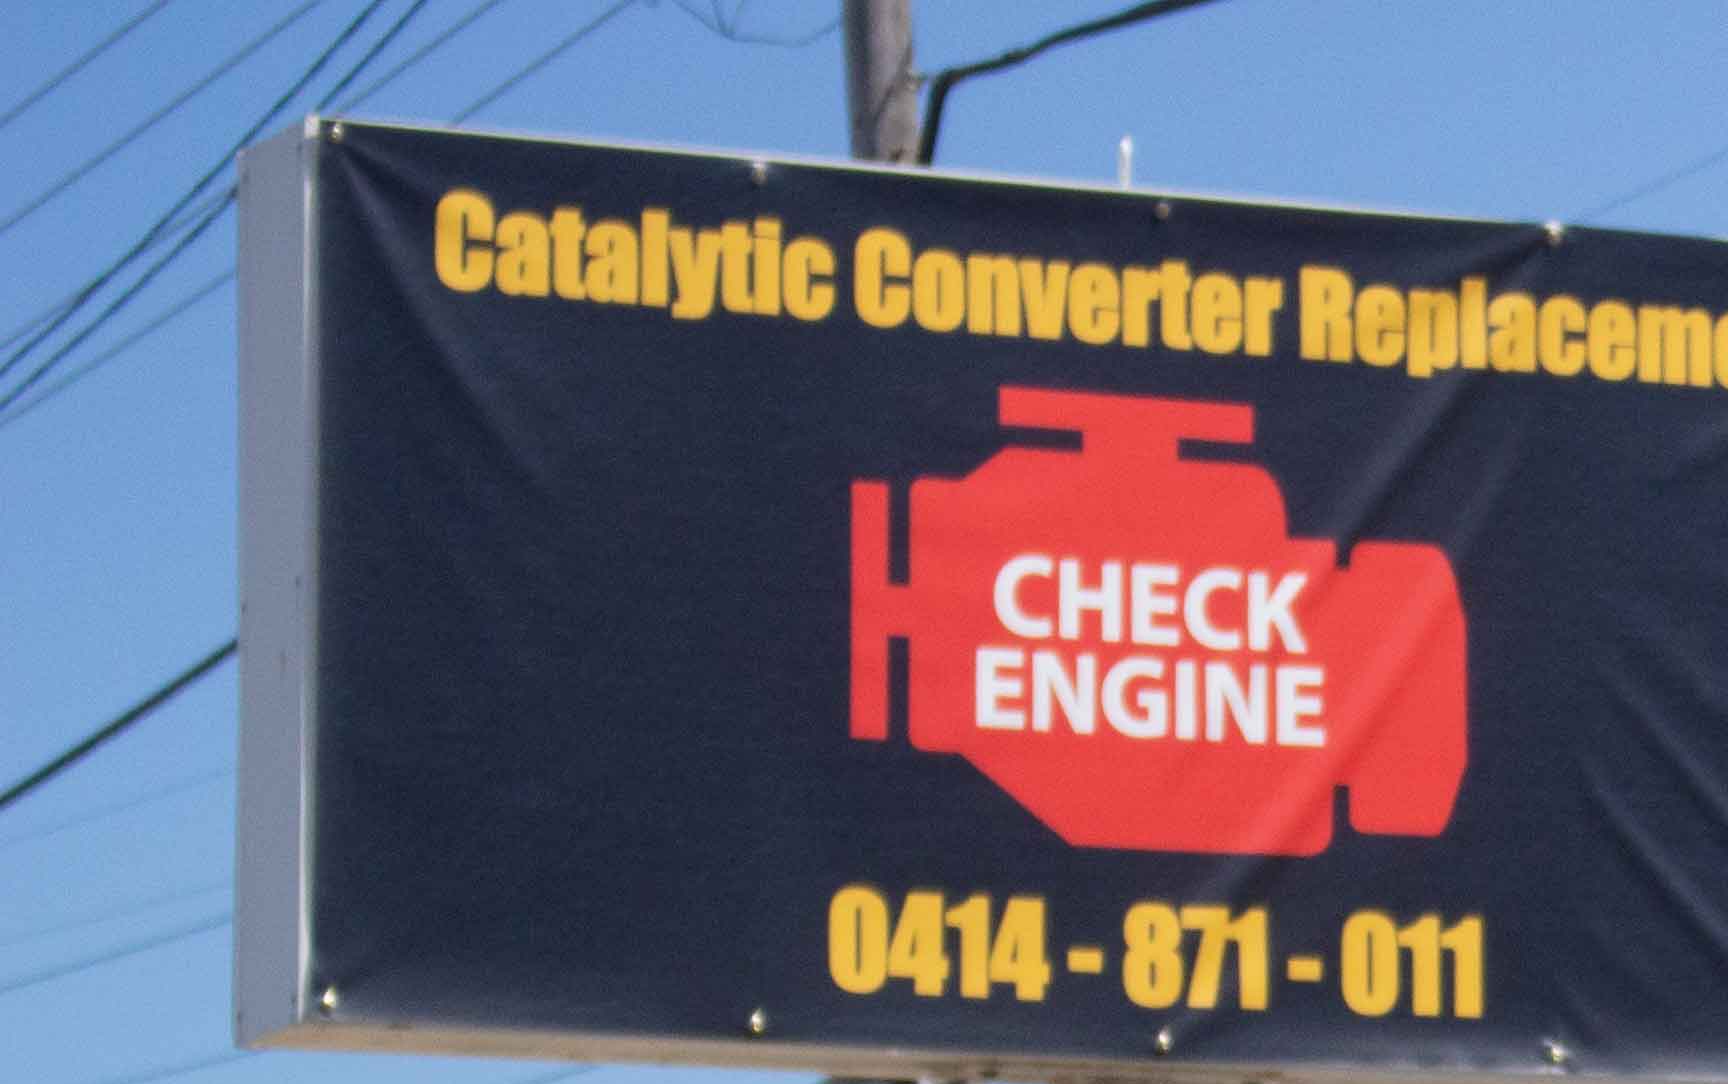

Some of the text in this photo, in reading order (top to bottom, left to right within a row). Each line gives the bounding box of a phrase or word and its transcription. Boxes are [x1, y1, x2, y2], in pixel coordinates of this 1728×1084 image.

[434, 186, 837, 320] Catalytic
[853, 225, 1284, 357] Converter
[992, 554, 1310, 656] CHECK
[974, 644, 1326, 748] ENGINE
[828, 884, 1052, 1003] 0414
[1121, 900, 1269, 1013] 871
[1339, 908, 1484, 1020] 011
